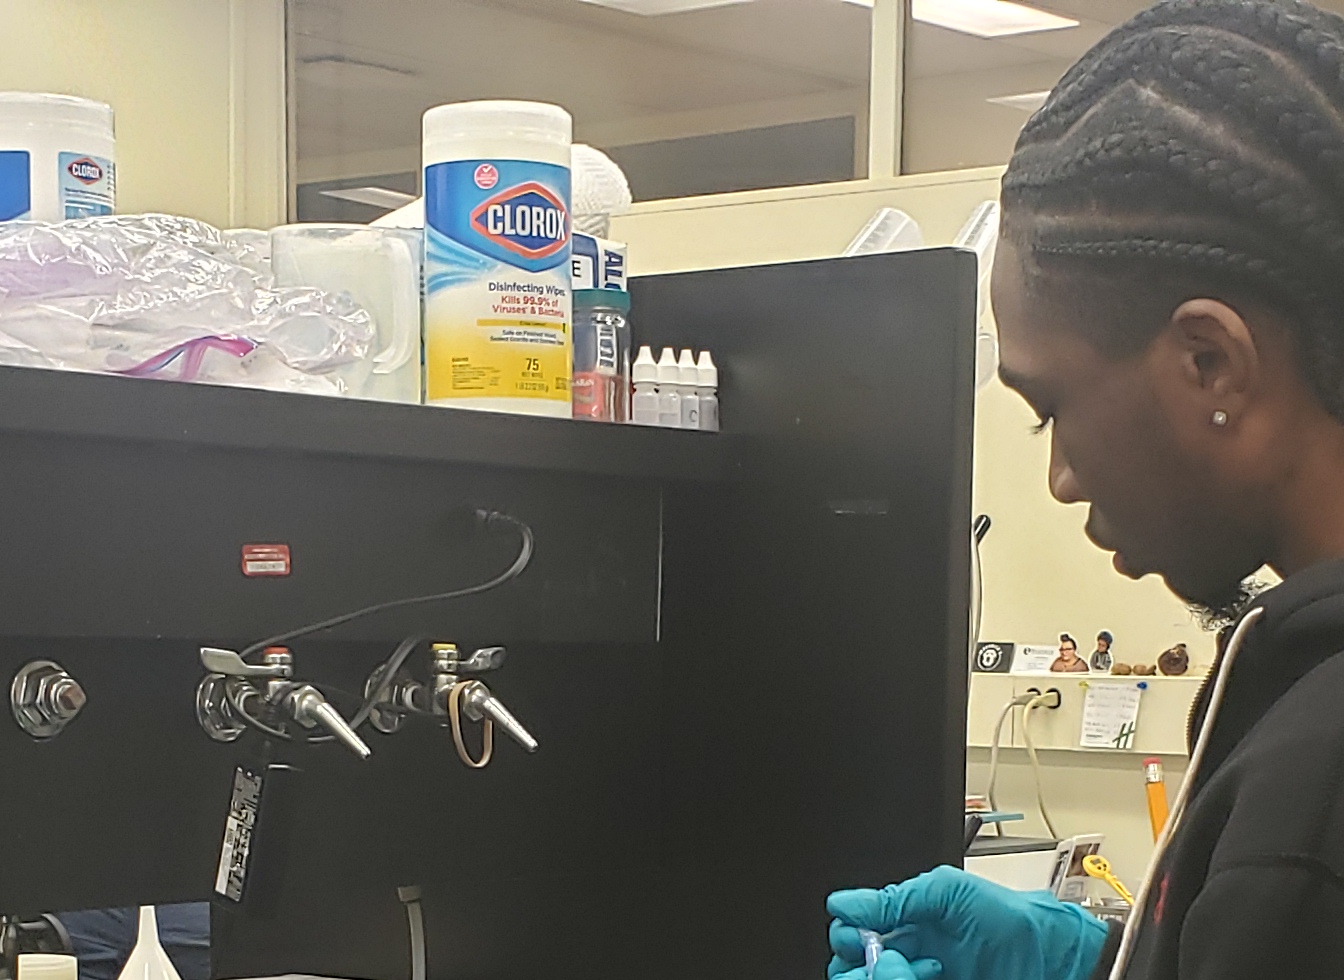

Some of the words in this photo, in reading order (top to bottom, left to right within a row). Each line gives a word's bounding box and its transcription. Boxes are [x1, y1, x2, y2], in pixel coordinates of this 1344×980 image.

[487, 204, 566, 241] CLOROX
[488, 281, 544, 295] Disinfecting
[501, 295, 520, 305] Kills
[523, 295, 551, 307] 99.9%
[530, 306, 537, 315] &
[526, 357, 540, 372] 75
